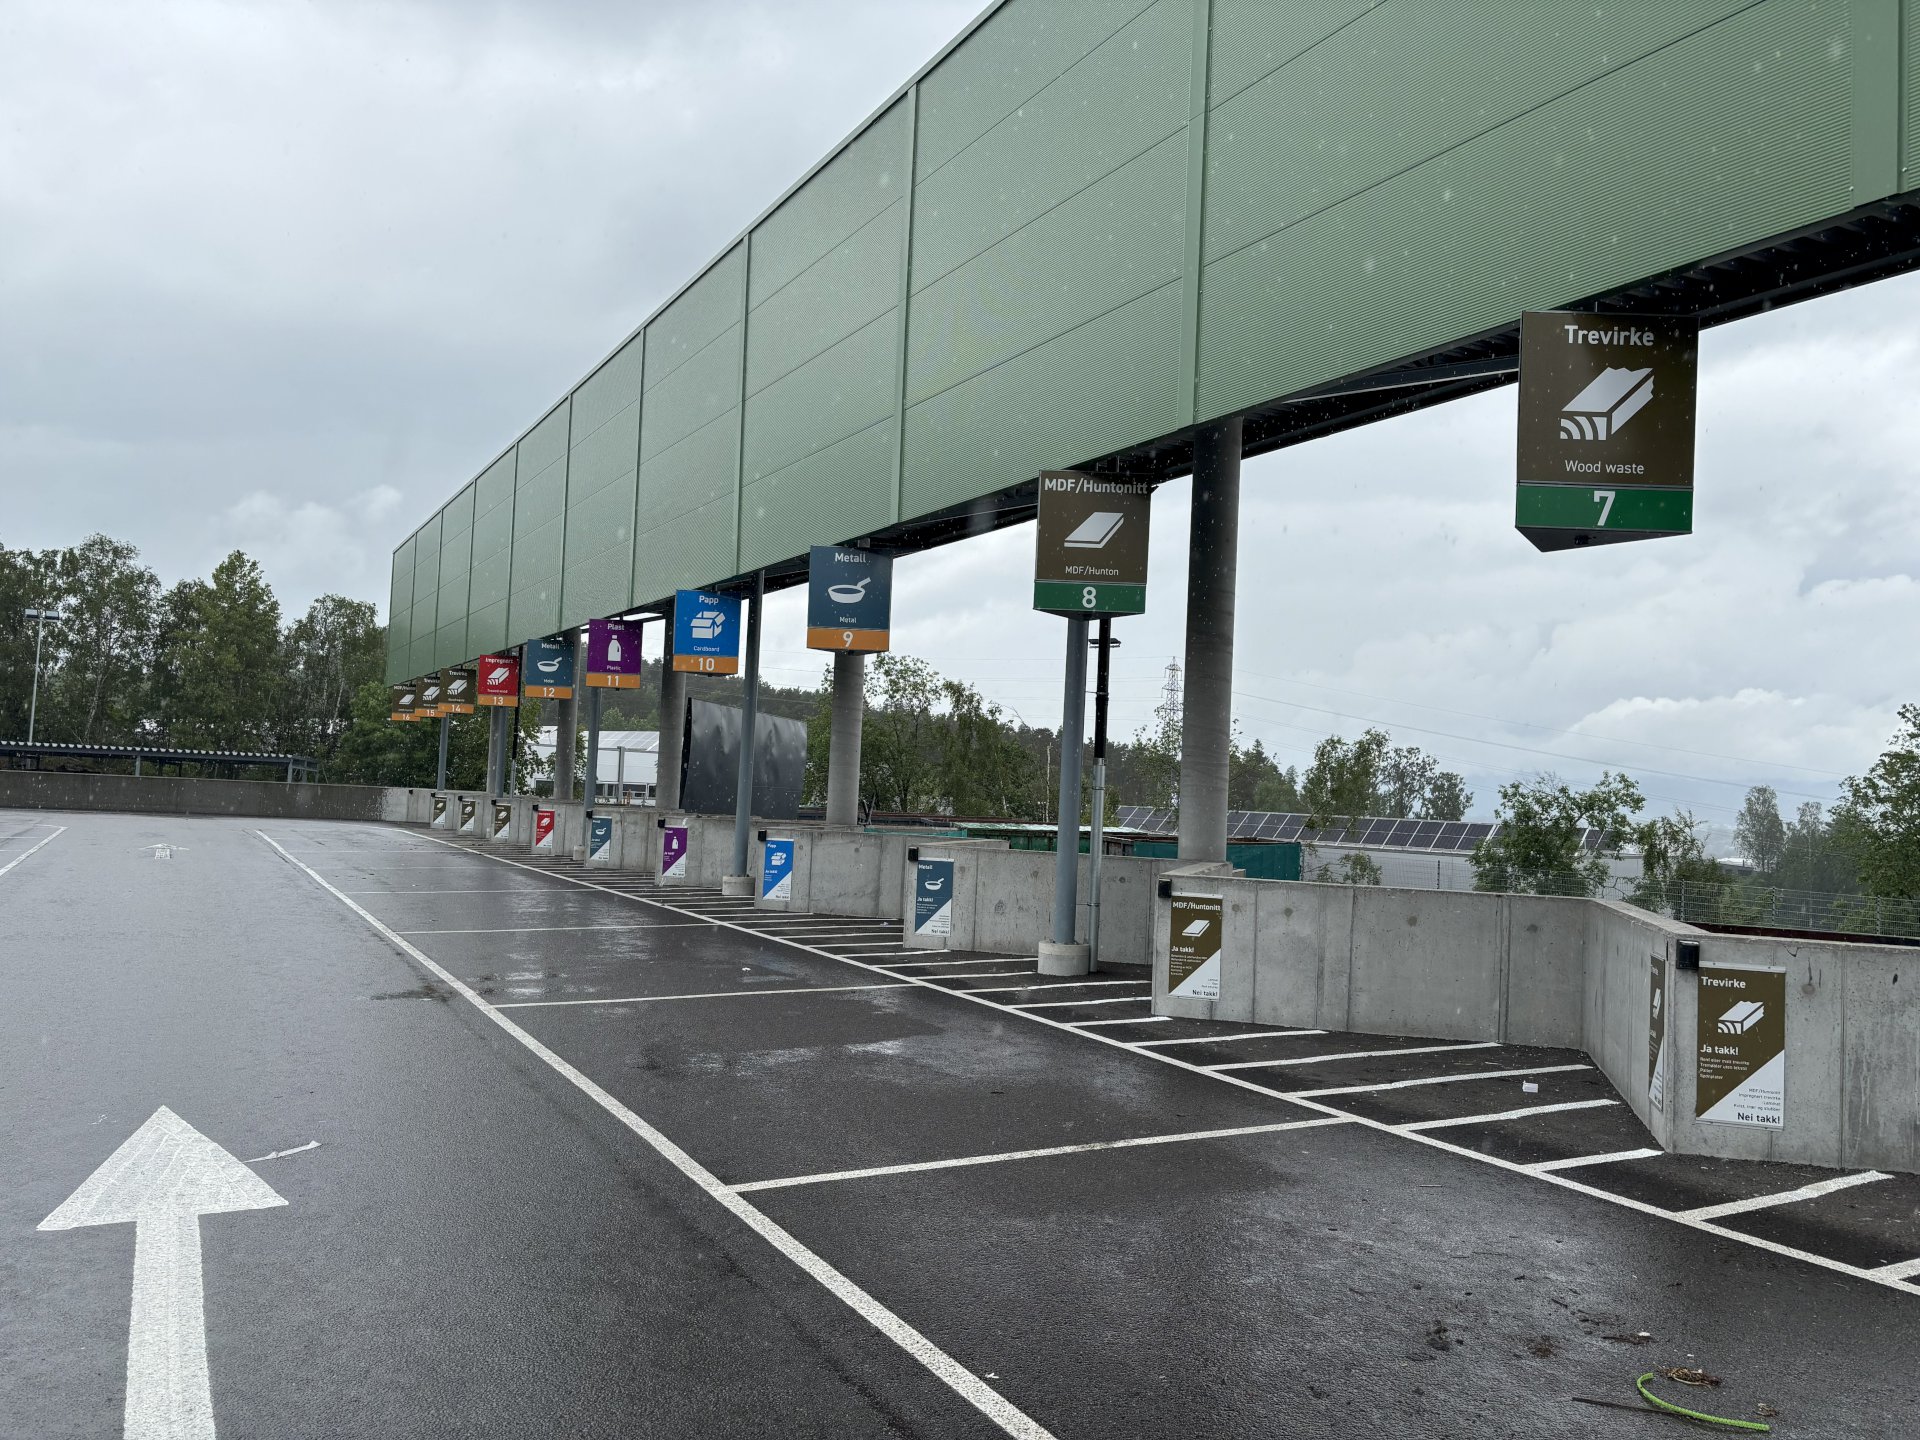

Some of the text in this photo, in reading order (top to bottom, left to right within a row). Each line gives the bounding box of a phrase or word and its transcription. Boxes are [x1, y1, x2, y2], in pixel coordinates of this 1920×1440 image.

[1564, 325, 1655, 346] Trevirke
[1565, 460, 1645, 475] Wood waste
[1044, 478, 1148, 495] MDF/Huntonitt
[1593, 490, 1616, 526] 7
[834, 552, 866, 563] Metall
[1065, 565, 1119, 576] MDF/Hunton
[699, 595, 719, 606] Papp
[1082, 586, 1097, 609] 8
[839, 616, 857, 624] Metal
[607, 623, 625, 631] Plast
[843, 631, 854, 647] 9
[698, 657, 715, 671] 10
[607, 675, 619, 686] 11
[543, 687, 555, 697] 12
[493, 696, 504, 705] 13
[426, 709, 435, 717] 15
[451, 704, 461, 713] 14
[1172, 901, 1221, 911] MDF/Huntonitt
[1700, 976, 1746, 989] Trevirke
[1700, 1044, 1739, 1056] Ja takk!
[1737, 1112, 1781, 1124] Nei takk!
